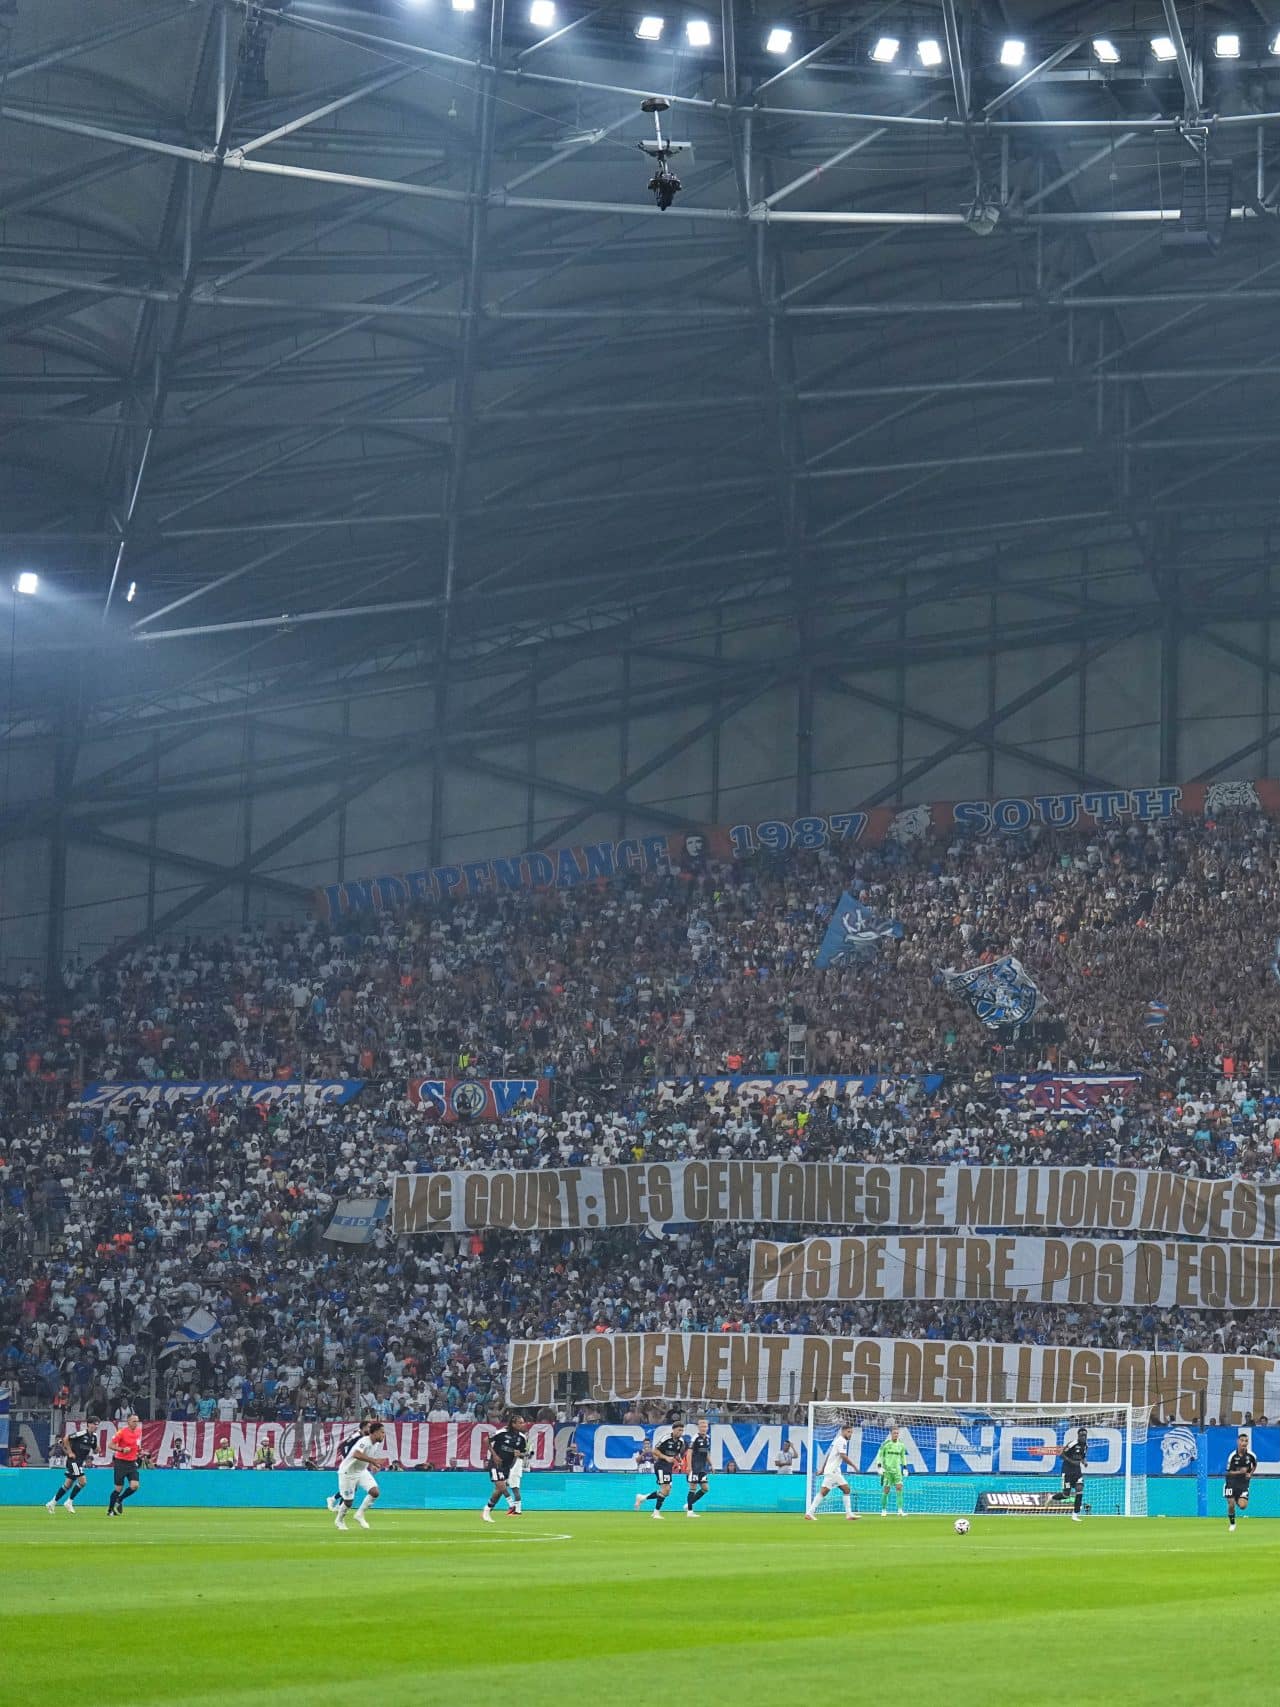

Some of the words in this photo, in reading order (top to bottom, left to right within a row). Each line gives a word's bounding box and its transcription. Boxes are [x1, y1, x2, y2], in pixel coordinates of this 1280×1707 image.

[729, 813, 868, 858] 1987
[954, 787, 1183, 834] SOUTH
[323, 835, 671, 926] INDEPENDANCE
[603, 1166, 673, 1225] DES
[683, 1162, 891, 1224] CENTAINES
[900, 1166, 944, 1226] DE
[956, 1168, 1136, 1227] MILLIONS
[751, 1240, 832, 1300] PAS
[837, 1238, 885, 1298] DE
[898, 1237, 1028, 1301] TITRE,
[1041, 1240, 1124, 1302] PAS
[511, 1333, 790, 1402] UNIQUEMENT
[803, 1337, 881, 1402] DES
[893, 1342, 1208, 1420] DESILLUSIONS
[1220, 1356, 1276, 1422] ET
[158, 1422, 216, 1466] AU
[447, 1423, 554, 1468] LOO
[986, 1493, 1040, 1506] UNIBET
